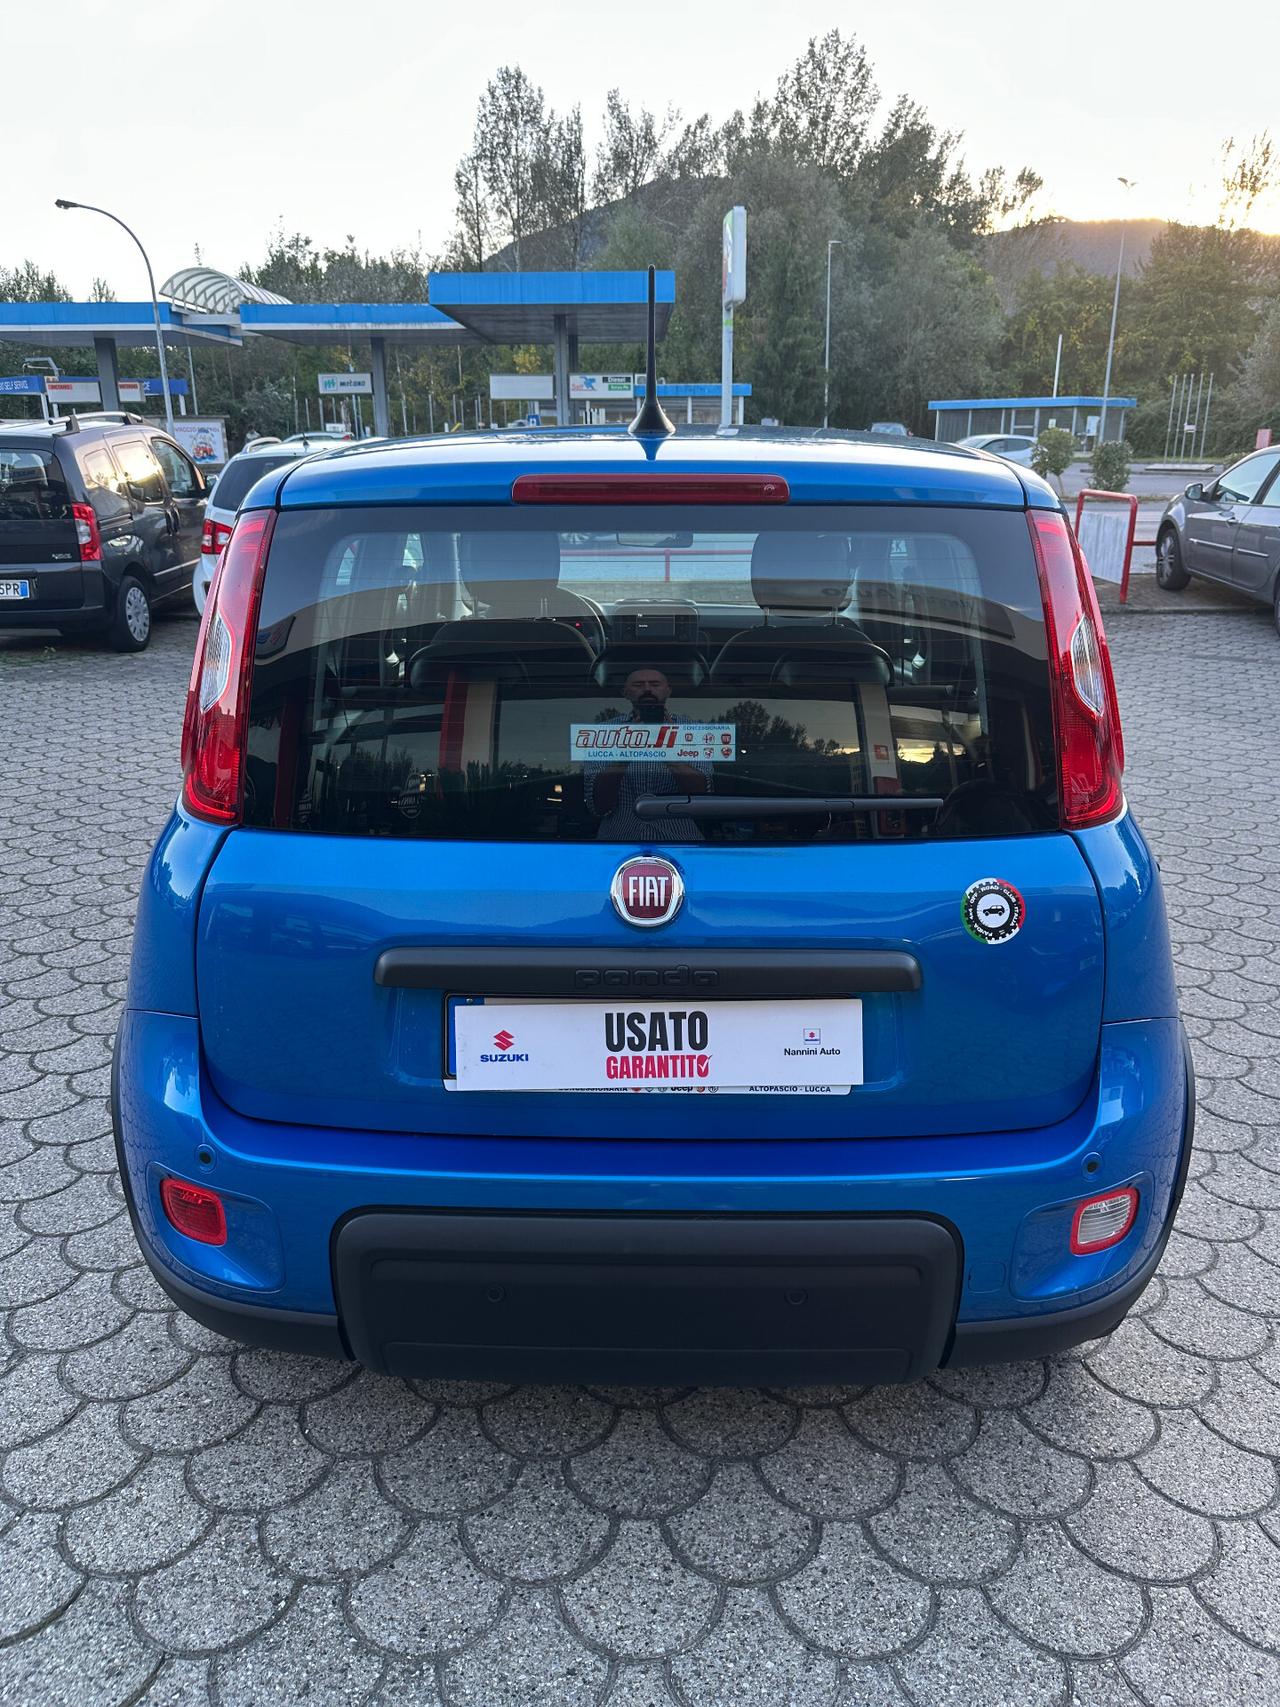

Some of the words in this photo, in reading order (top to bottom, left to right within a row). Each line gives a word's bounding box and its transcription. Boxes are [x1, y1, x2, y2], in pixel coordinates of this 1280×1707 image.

[677, 749, 699, 758] Jeep
[628, 876, 669, 907] FIAT
[970, 892, 978, 904] OFF
[1003, 889, 1017, 903] CLUB
[1009, 906, 1019, 927] ITALIA
[575, 964, 721, 990] panda
[604, 1011, 709, 1052] USATO
[480, 1053, 529, 1063] SUZUKI
[784, 1048, 818, 1056] Nannini
[819, 1047, 841, 1056] Auto
[606, 1054, 712, 1079] GARANTITO
